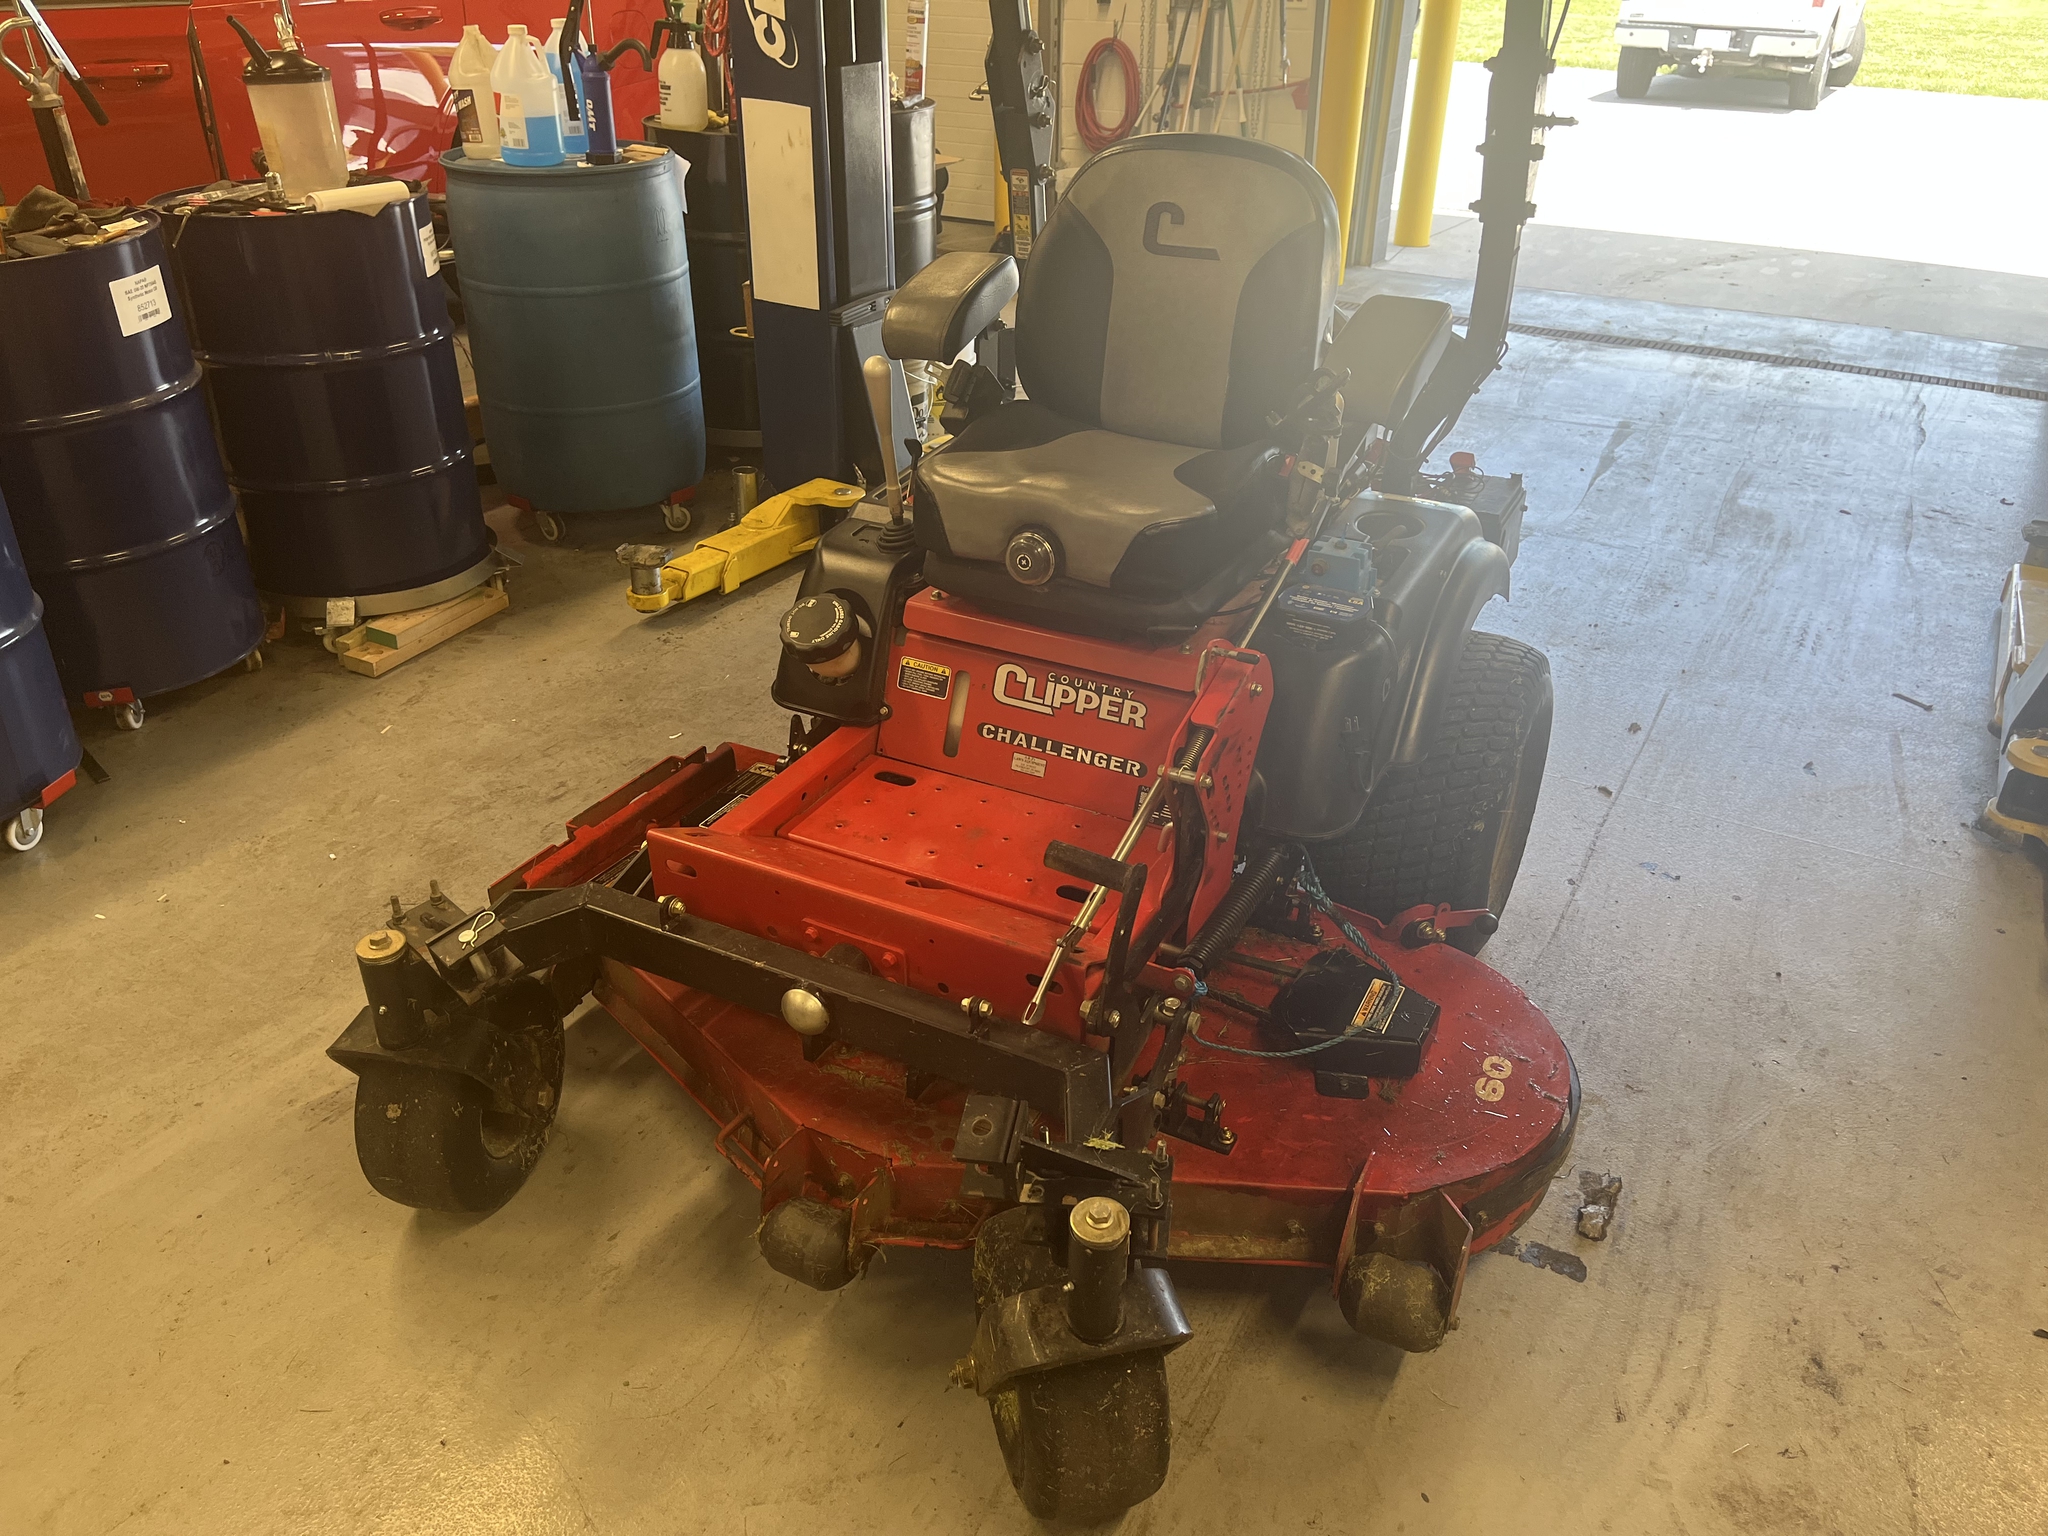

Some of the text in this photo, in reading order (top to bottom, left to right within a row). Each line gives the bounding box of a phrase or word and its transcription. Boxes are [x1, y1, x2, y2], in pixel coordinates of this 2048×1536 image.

[913, 661, 939, 673] CAUTION
[1048, 672, 1134, 699] COUNTRY
[993, 663, 1147, 729] CLIPPER
[982, 723, 1142, 777] CHALLENGER
[1474, 1055, 1513, 1102] 60
